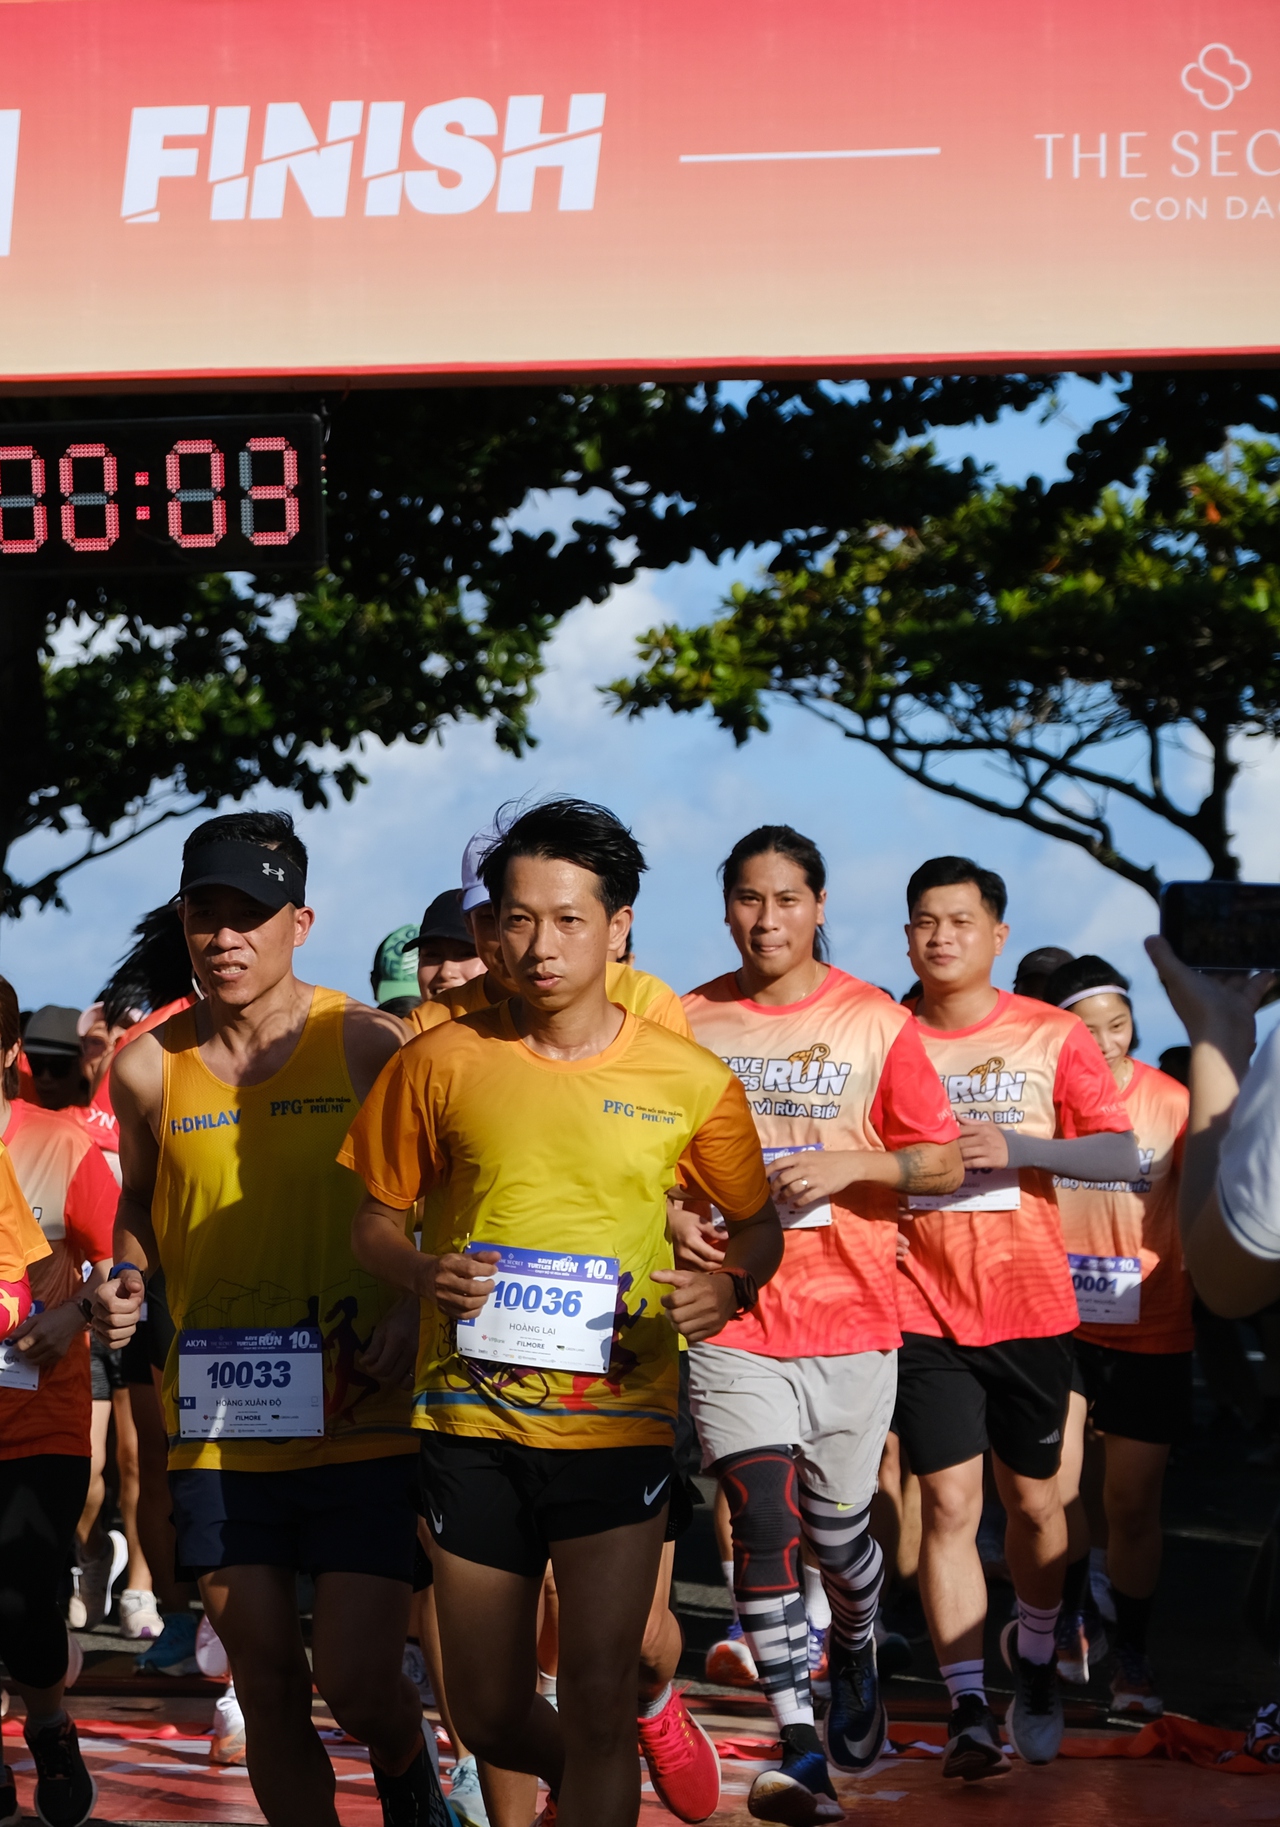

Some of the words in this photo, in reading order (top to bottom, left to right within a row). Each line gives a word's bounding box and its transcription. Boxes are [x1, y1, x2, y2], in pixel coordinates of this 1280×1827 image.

[121, 92, 607, 224] FINISH
[1034, 132, 1148, 180] THE
[1129, 196, 1208, 223] CON
[1226, 195, 1280, 221] DA
[763, 1058, 852, 1096] RUN
[947, 1071, 1027, 1104] RUN
[271, 1099, 303, 1116] PFG
[603, 1099, 635, 1118] PFG
[774, 1098, 809, 1117] RÙA
[552, 1259, 579, 1273] RUN
[584, 1259, 607, 1278] 10
[1118, 1258, 1135, 1272] 10
[493, 1280, 583, 1317] 10036
[509, 1322, 540, 1334] HOÀNG
[258, 1335, 282, 1346] RUN
[289, 1330, 310, 1349] 10
[516, 1340, 545, 1350] FILMORE
[207, 1361, 292, 1389] 10033
[183, 1399, 191, 1407] M
[216, 1398, 243, 1407] HOÀNG
[244, 1398, 267, 1407] XUÂN
